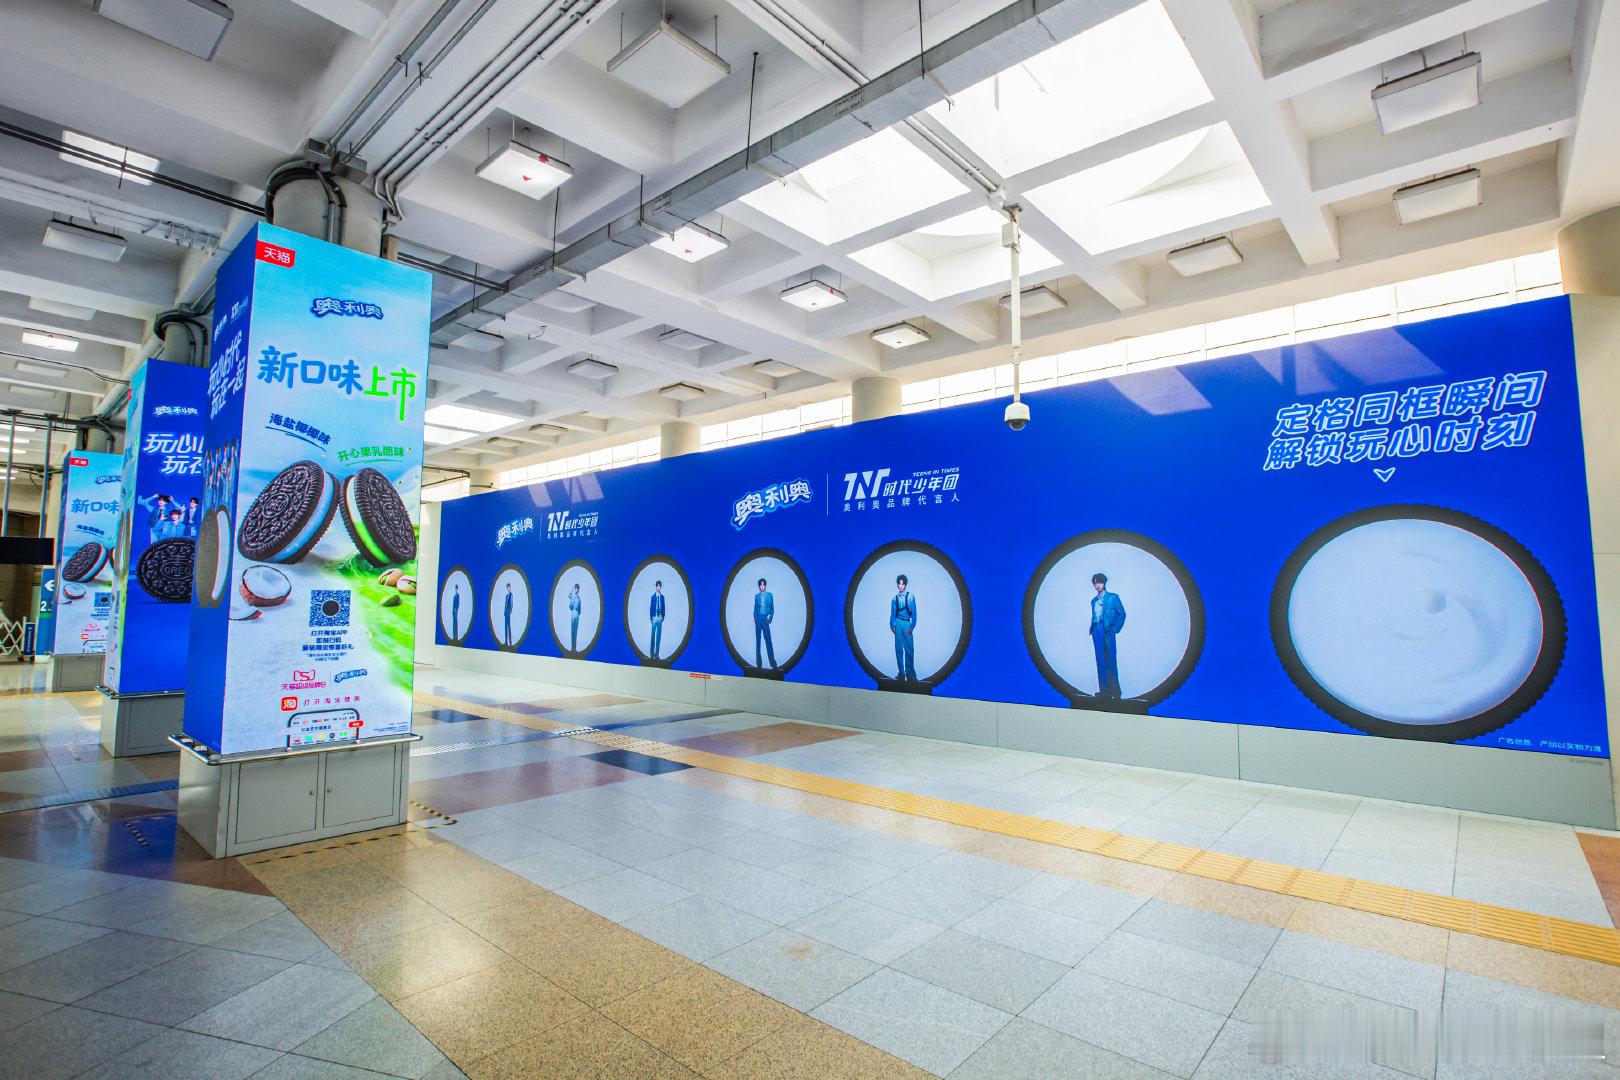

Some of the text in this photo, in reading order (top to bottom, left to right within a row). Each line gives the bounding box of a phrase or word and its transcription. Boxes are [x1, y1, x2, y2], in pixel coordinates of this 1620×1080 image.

[264, 247, 290, 264] 天猫
[311, 297, 384, 319] 奥利奥
[257, 346, 418, 421] 新口味上市
[1272, 370, 1547, 437] 定格同框瞬间
[269, 413, 331, 445] 海盐椰椰味
[143, 434, 204, 453] 玩心
[1263, 411, 1536, 470] 解锁玩心时刻
[337, 446, 404, 462] 开心果乳酪味
[883, 474, 960, 496] 时代少年团
[72, 498, 119, 514] 新口味
[733, 480, 812, 527] 奥利奥
[844, 492, 960, 512] 奥利奥品牌代言人
[496, 517, 534, 547] 奥利奥
